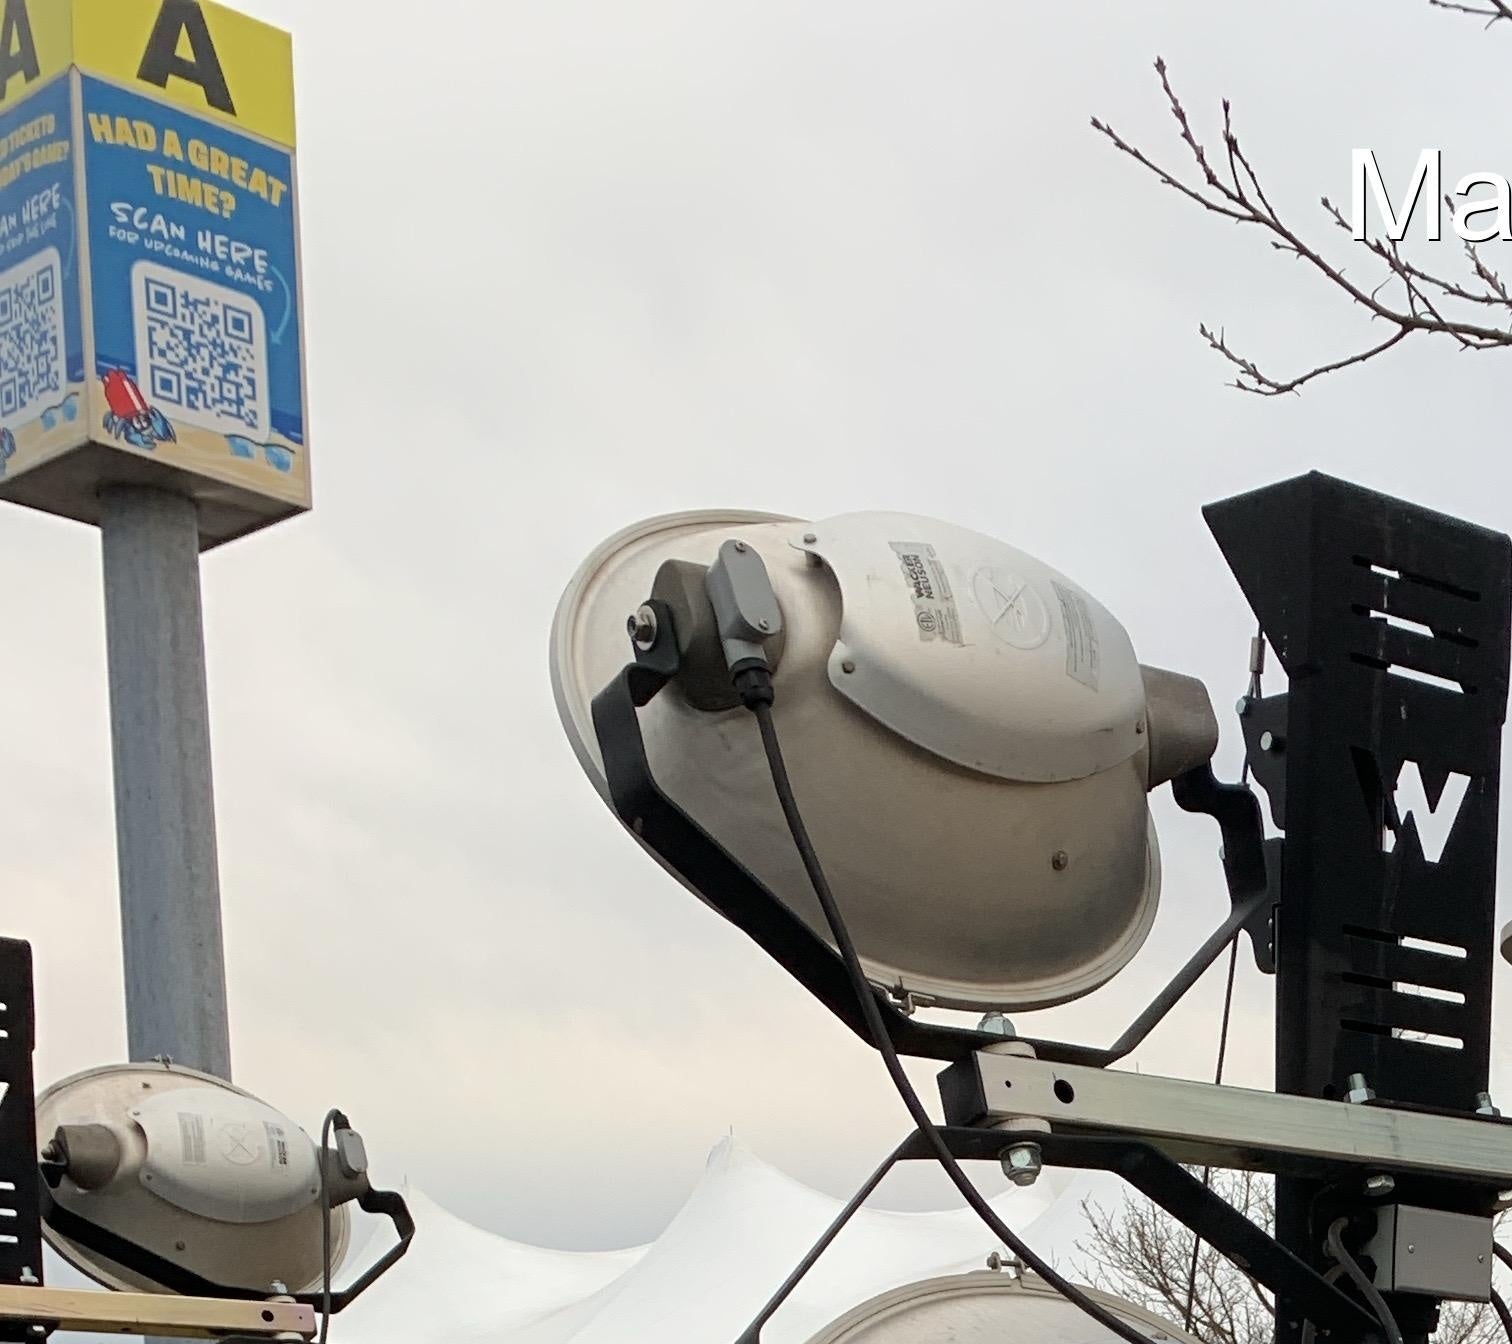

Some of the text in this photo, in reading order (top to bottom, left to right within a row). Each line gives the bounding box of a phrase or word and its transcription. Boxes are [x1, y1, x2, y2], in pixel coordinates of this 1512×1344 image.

[137, 0, 237, 117] A
[88, 113, 287, 208] HAD A GREAT
[147, 164, 236, 219] TIME?
[22, 182, 60, 225] HERE
[109, 225, 273, 292] FOR UPCOMING GAMES
[110, 202, 268, 274] SCAN HERE
[911, 554, 935, 600] NEUSON
